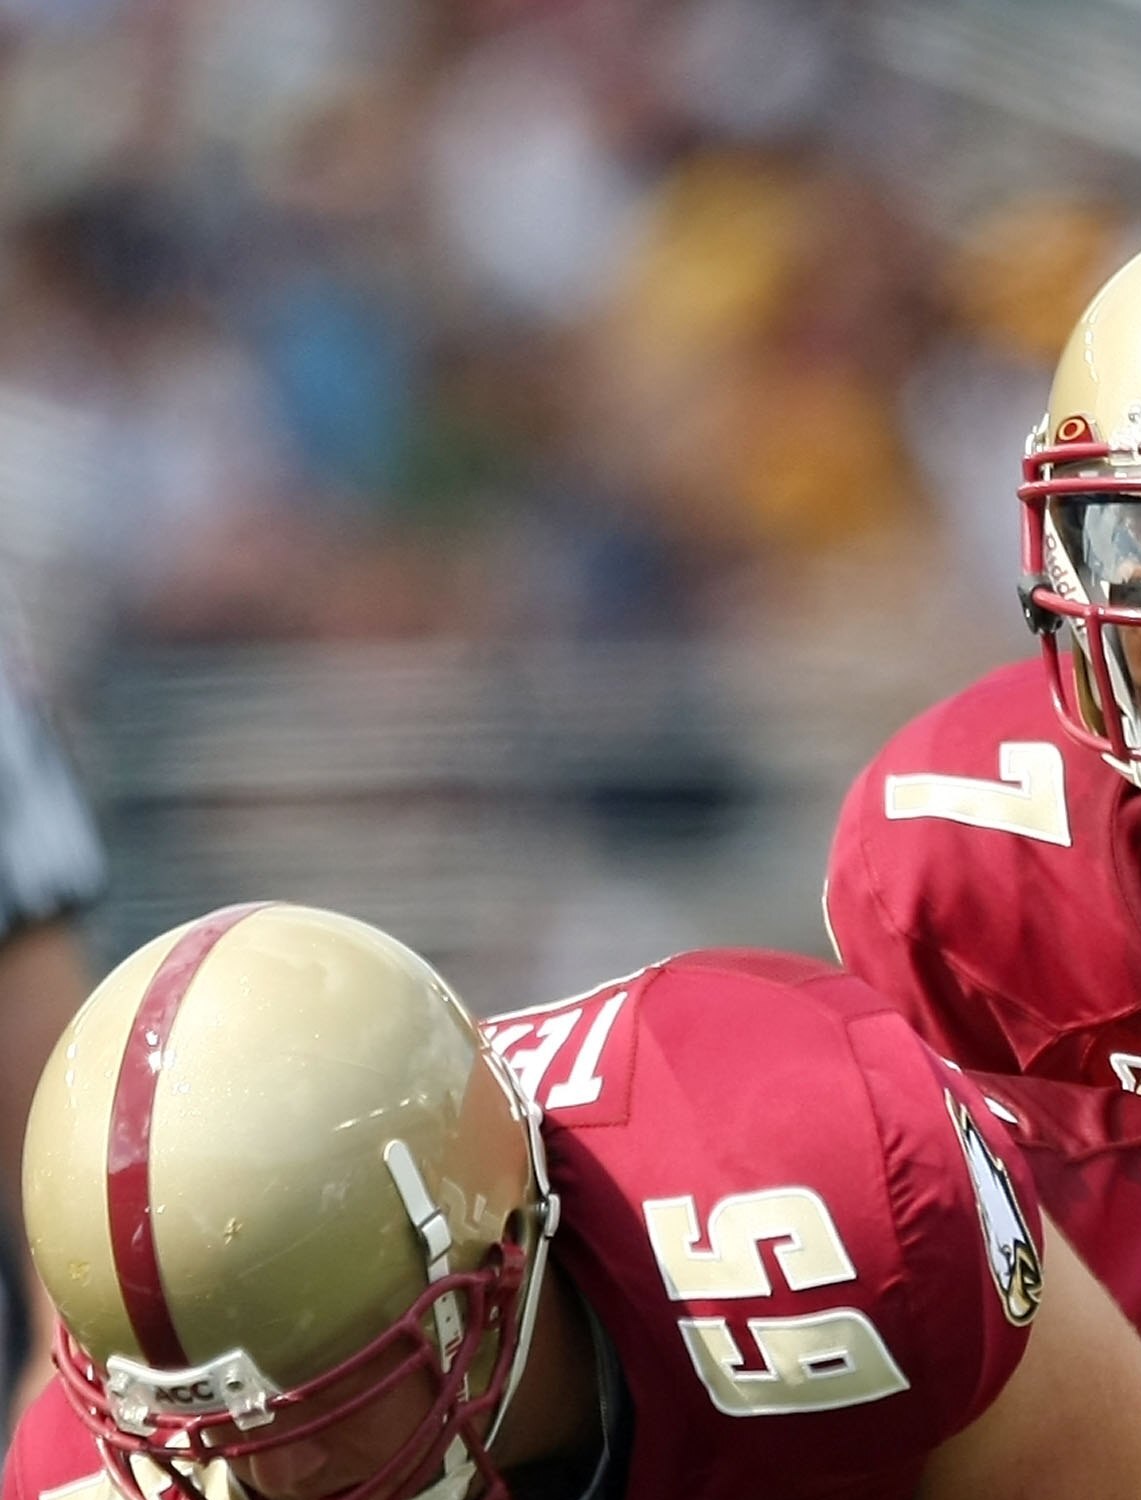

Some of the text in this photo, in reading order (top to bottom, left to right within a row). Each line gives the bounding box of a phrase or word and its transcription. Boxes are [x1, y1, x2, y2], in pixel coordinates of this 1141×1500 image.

[885, 741, 1073, 848] 7
[642, 1185, 911, 1418] 65
[155, 1379, 214, 1404] ACC
